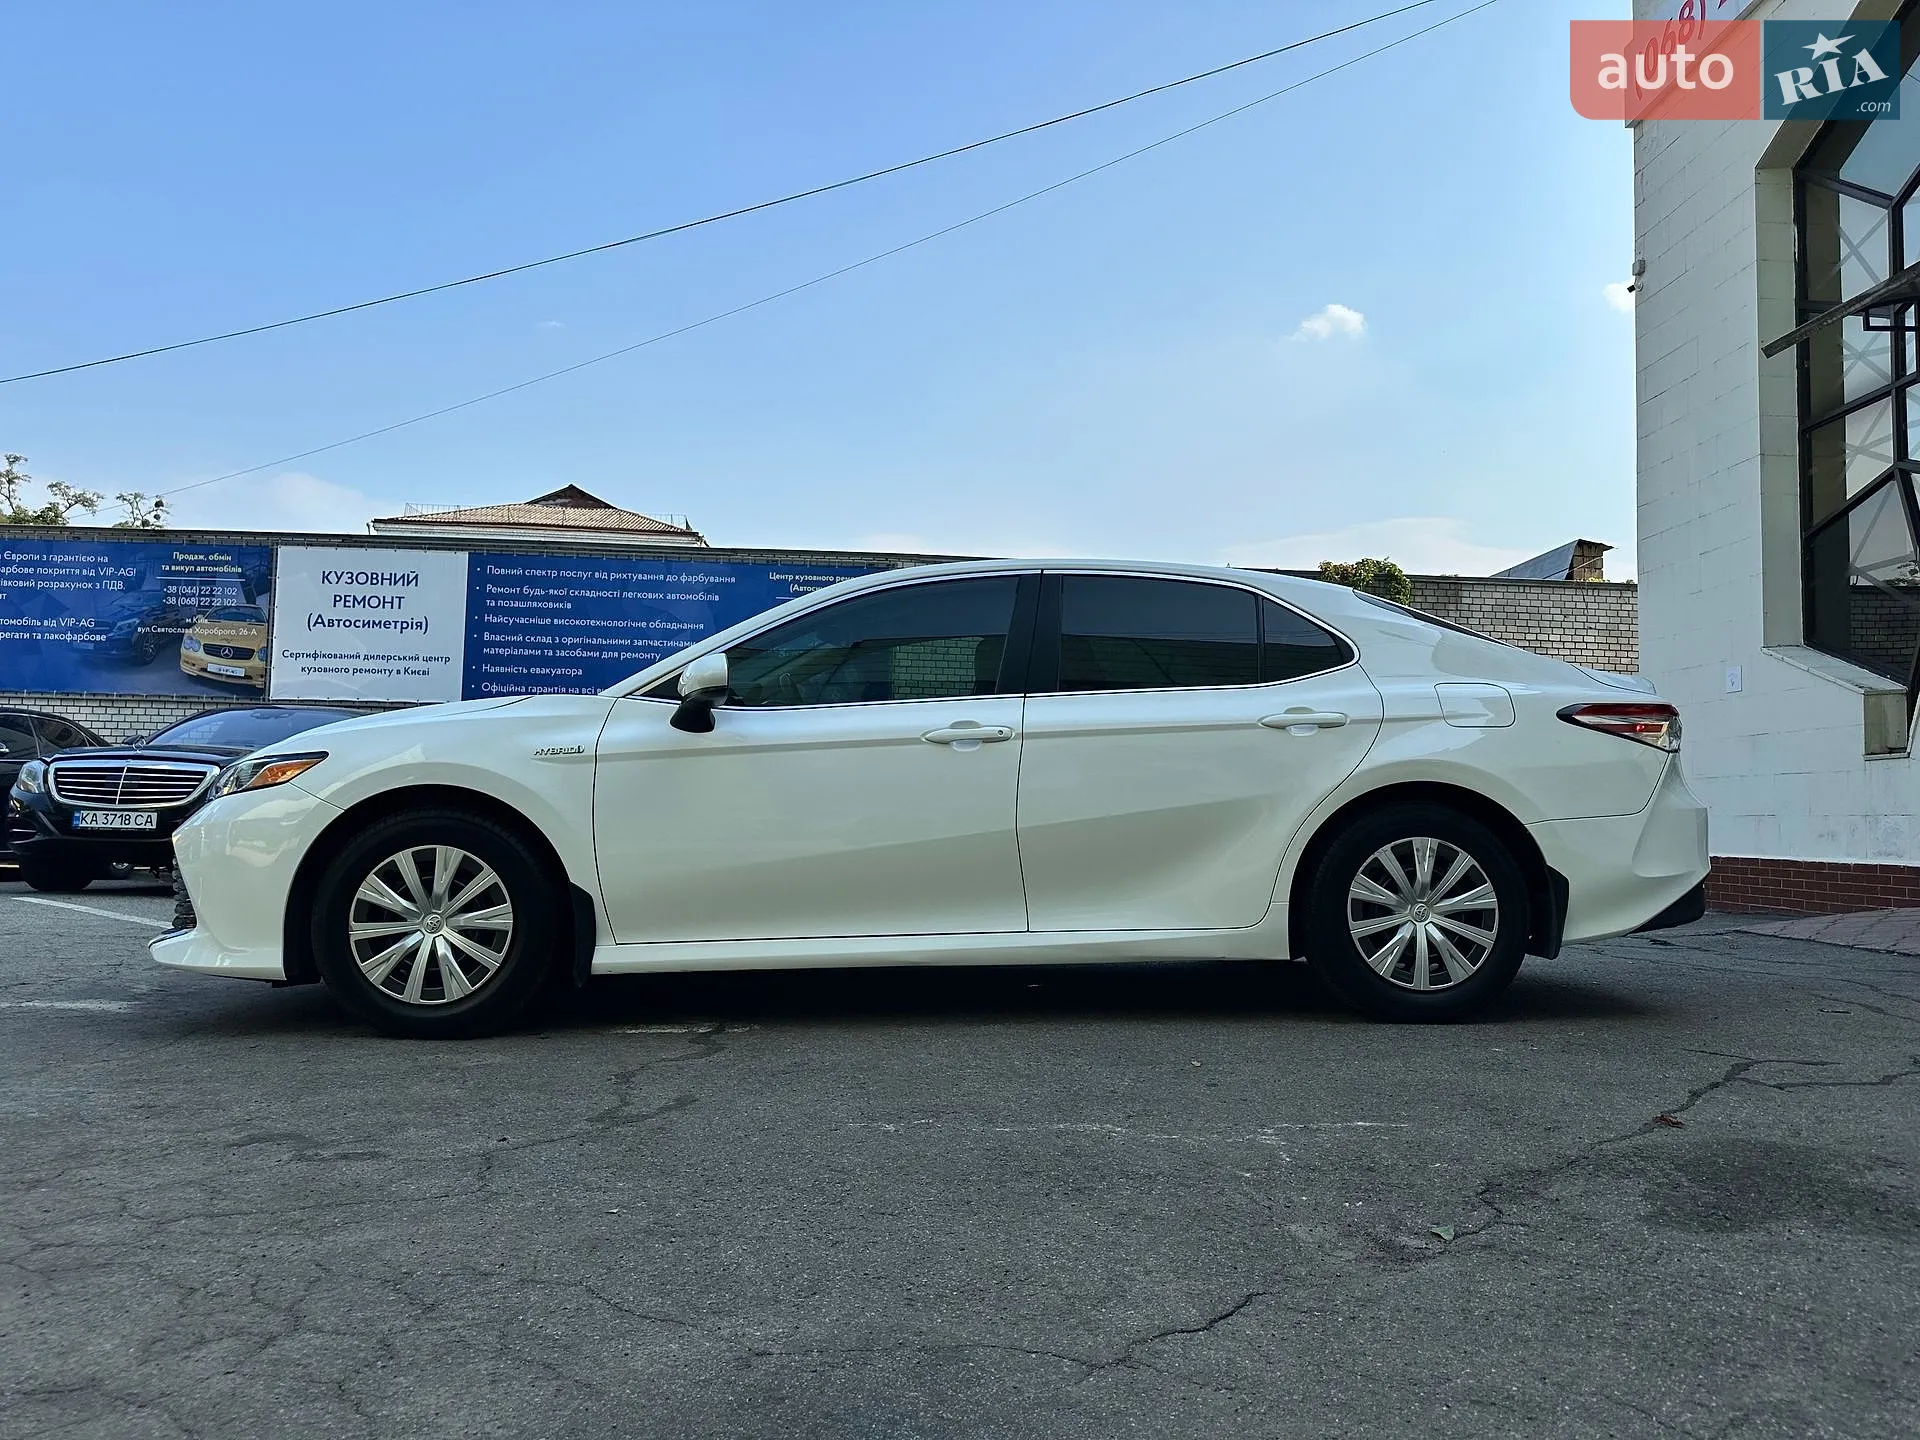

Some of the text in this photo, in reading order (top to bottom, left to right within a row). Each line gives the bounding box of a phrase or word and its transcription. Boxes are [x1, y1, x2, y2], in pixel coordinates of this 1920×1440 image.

[4, 551, 40, 562] Європи
[50, 554, 95, 563] гарантією
[98, 555, 108, 563] на
[173, 552, 232, 561] Продаж, обмін
[36, 567, 80, 576] покриття
[82, 568, 96, 576] від
[98, 567, 136, 577] VIP-AG!
[196, 565, 242, 573] автомобілів
[321, 570, 419, 587] КУЗОВНИЙ
[487, 566, 736, 585] Повний спектр послуг від рихтування до фарбування
[769, 572, 794, 582] Центр
[795, 574, 834, 582] кузовного
[38, 581, 93, 590] розрахунок
[178, 586, 200, 596] (044)
[200, 587, 211, 595] 22
[224, 588, 238, 596] 102
[486, 585, 720, 602] Ремонт будь-якої складності легкових автомобілів
[178, 597, 199, 607] (068)
[200, 598, 210, 606] 22
[212, 598, 222, 606] 22
[224, 598, 237, 606] 102
[332, 594, 405, 610] РЕМОНТ
[498, 600, 572, 610] позашляховиків
[44, 618, 56, 627] від
[60, 618, 94, 628] VIP-AG
[307, 612, 429, 635] (Автосиметрія)
[484, 614, 704, 631] Найсучасніше високотехнологічне обладнання
[32, 632, 42, 640] та
[44, 631, 106, 642] лакофарбове
[484, 632, 523, 642] Власний
[525, 634, 553, 644] склад
[554, 636, 560, 644] з
[562, 636, 631, 646] оригінальними
[282, 650, 451, 664] Сертифікований дилерський центр
[483, 647, 542, 657] матеріалами
[555, 648, 600, 658] засобами
[602, 651, 618, 660] для
[620, 652, 661, 661] ремонту
[301, 666, 350, 676] кузовного
[352, 668, 393, 677] ремонту
[403, 666, 430, 676] Києві
[482, 664, 582, 676] Наявність евакуатора
[482, 682, 526, 694] Офіційна
[528, 684, 566, 695] гарантія
[582, 686, 594, 695] всі
[102, 813, 132, 826] 3718
